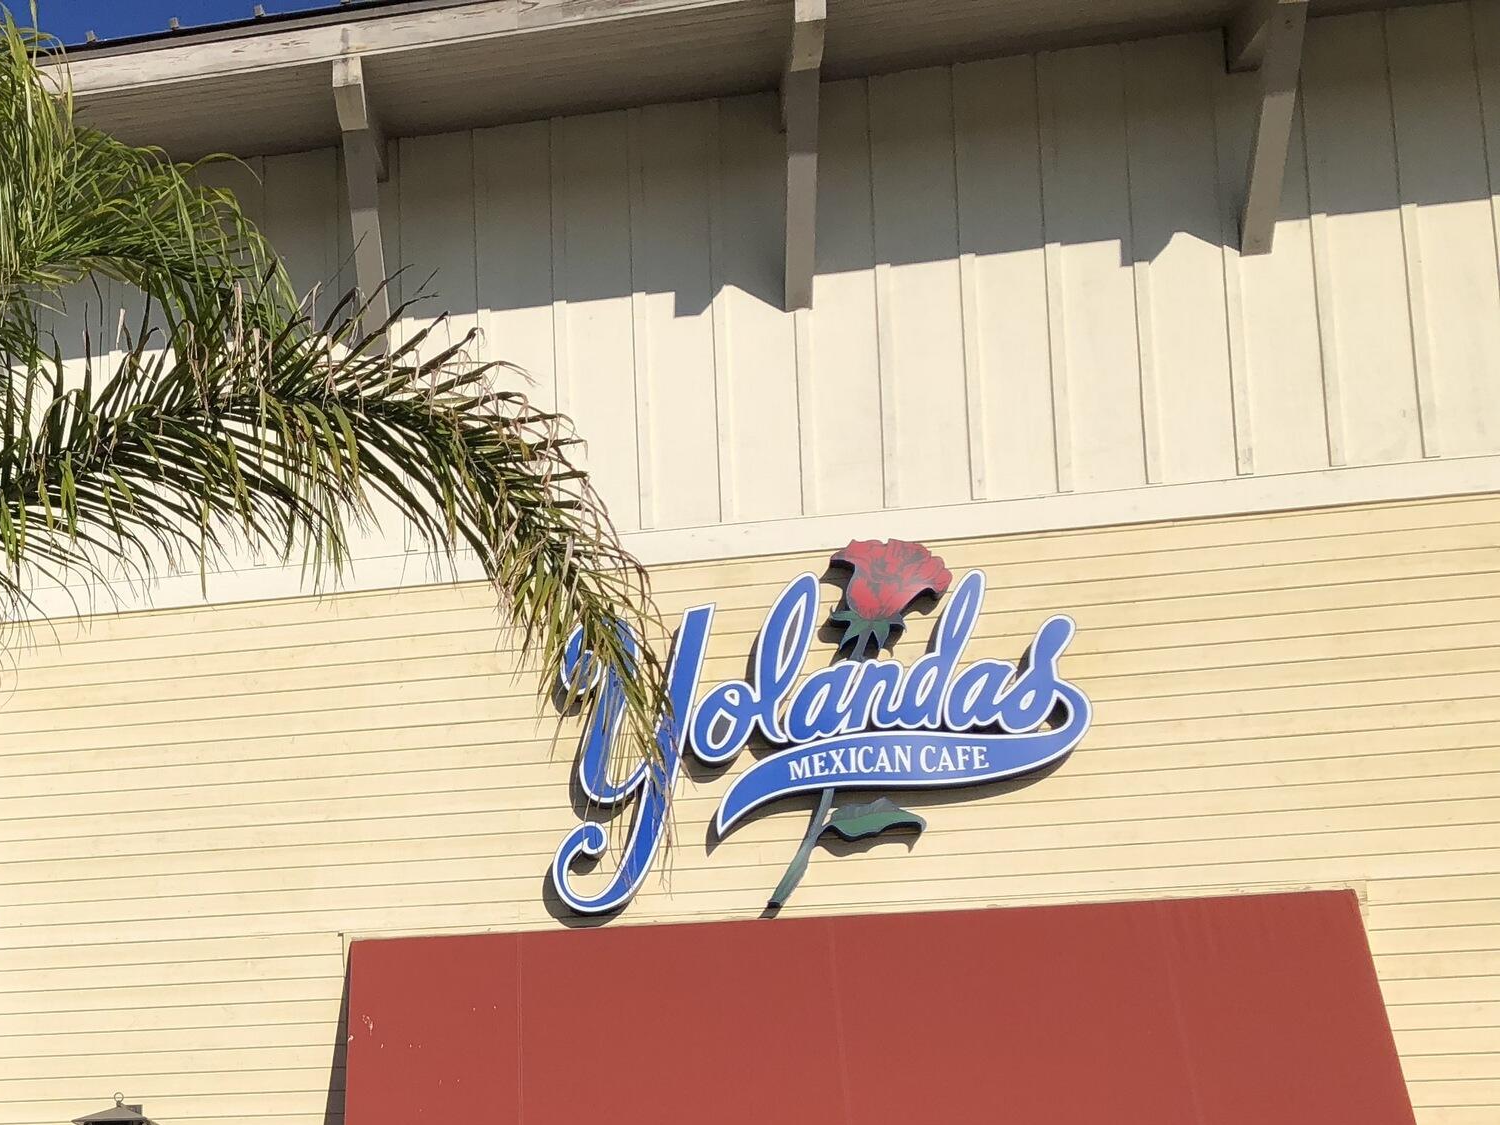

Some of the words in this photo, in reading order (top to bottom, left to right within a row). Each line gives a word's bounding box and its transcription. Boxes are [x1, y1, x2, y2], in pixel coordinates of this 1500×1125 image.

[552, 568, 1093, 914] Yolandas
[787, 745, 912, 781] MEXICAN
[919, 745, 990, 773] CAFE
